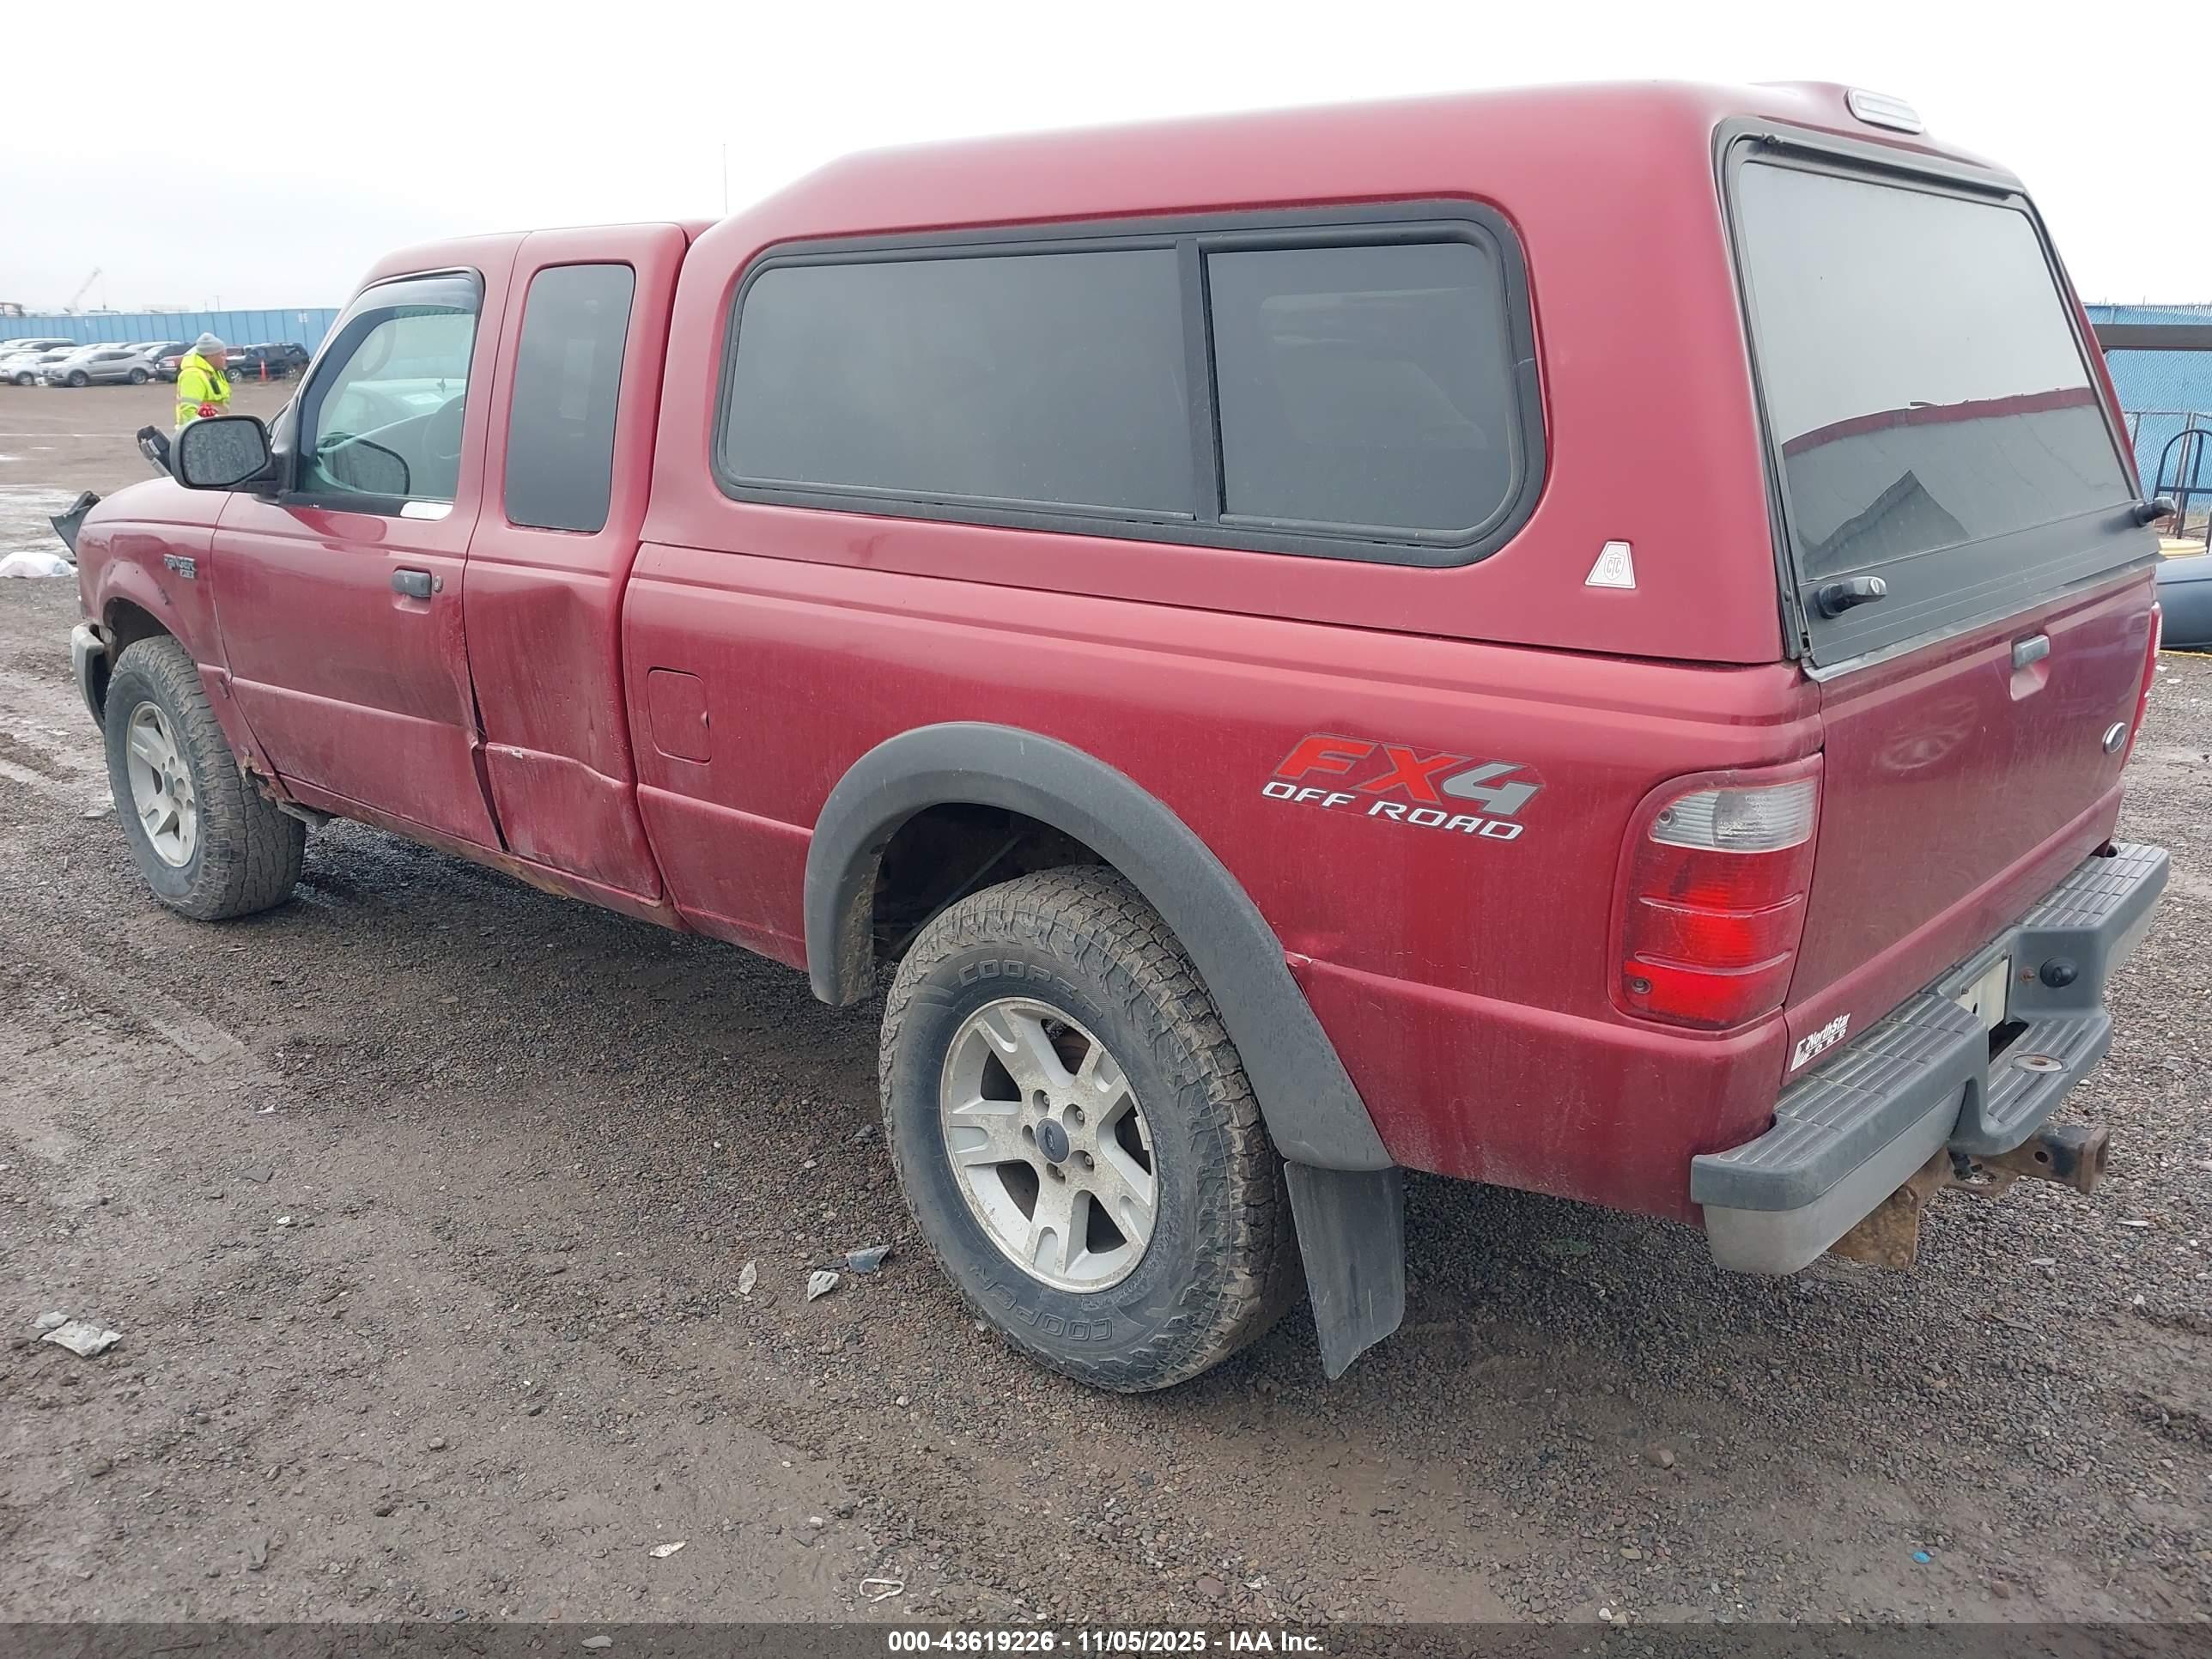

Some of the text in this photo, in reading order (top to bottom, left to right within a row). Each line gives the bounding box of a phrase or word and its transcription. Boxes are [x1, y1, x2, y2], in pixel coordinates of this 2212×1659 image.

[1272, 732, 1543, 817] FX4
[1261, 781, 1524, 841] OFF ROAD
